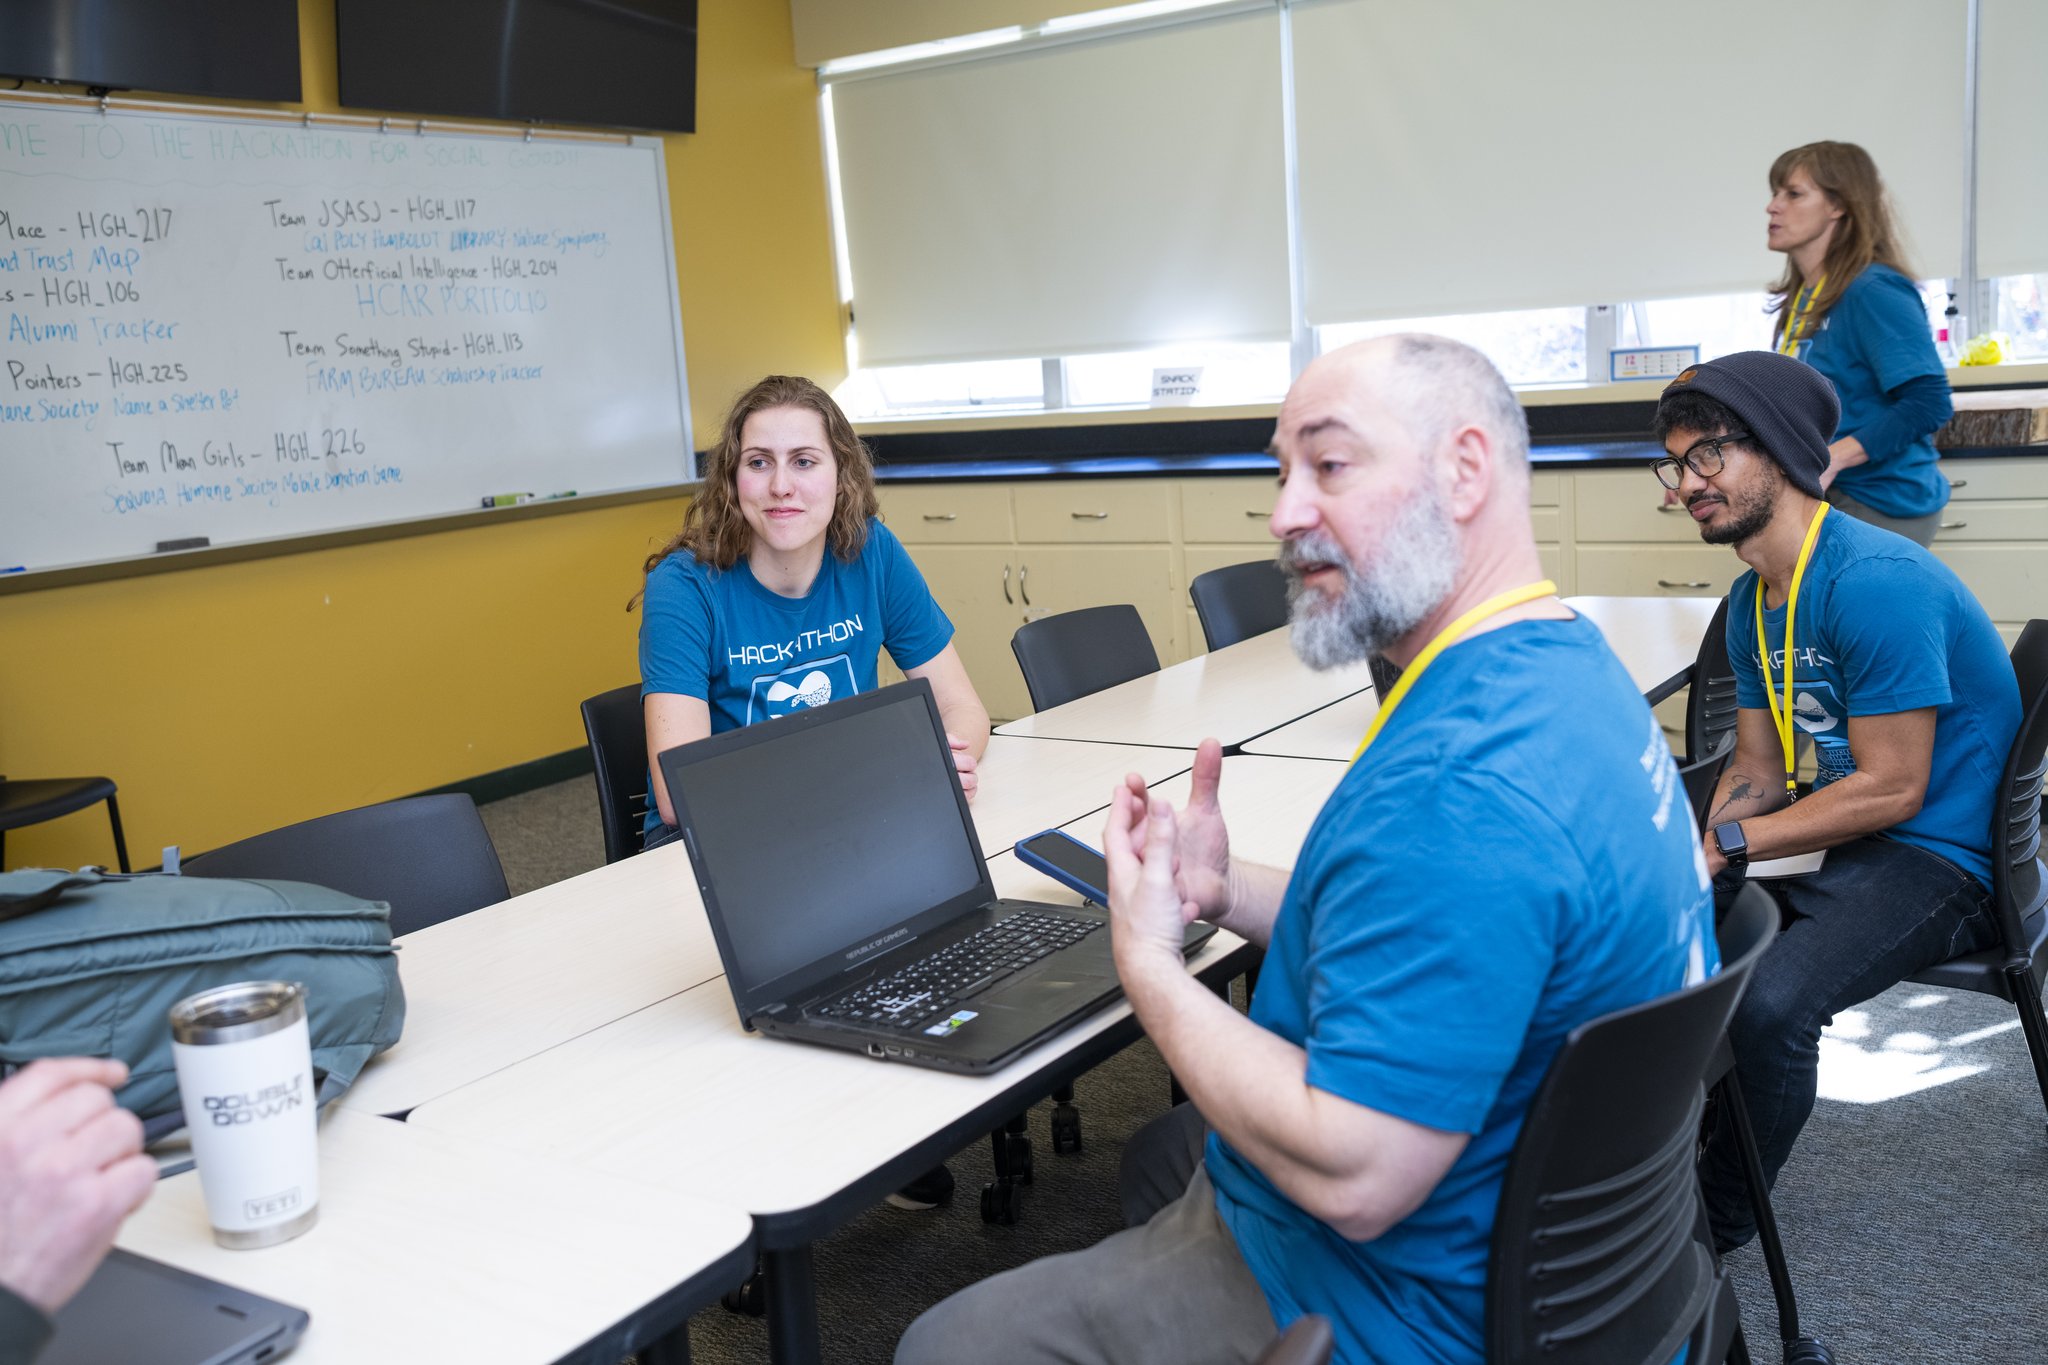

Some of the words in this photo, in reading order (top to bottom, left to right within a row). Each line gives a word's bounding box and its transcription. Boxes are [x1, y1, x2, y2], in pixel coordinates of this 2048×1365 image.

[74, 122, 125, 160] TO
[143, 123, 194, 160] THE
[208, 129, 352, 161] HACKATHON
[369, 140, 409, 165] FOR
[424, 146, 490, 168] SOCIAL
[77, 207, 173, 244] HGH_217
[263, 199, 306, 228] Team
[318, 199, 382, 228] JSASJ
[23, 246, 75, 273] Trust
[88, 245, 140, 276] Map
[275, 257, 314, 281] Team
[42, 276, 140, 307] HGH_106
[440, 284, 547, 317] PORTFOLIO
[9, 312, 78, 345] Alumni
[89, 316, 179, 345] Tracker
[279, 330, 325, 358] Team
[335, 332, 402, 367] Something
[7, 359, 82, 391] Pointers
[108, 355, 188, 389] HGH_225
[38, 399, 99, 432] Society
[105, 441, 150, 478] Team
[203, 440, 246, 469] Girls
[274, 428, 366, 463] HGH_226
[249, 1194, 297, 1217] YETI
